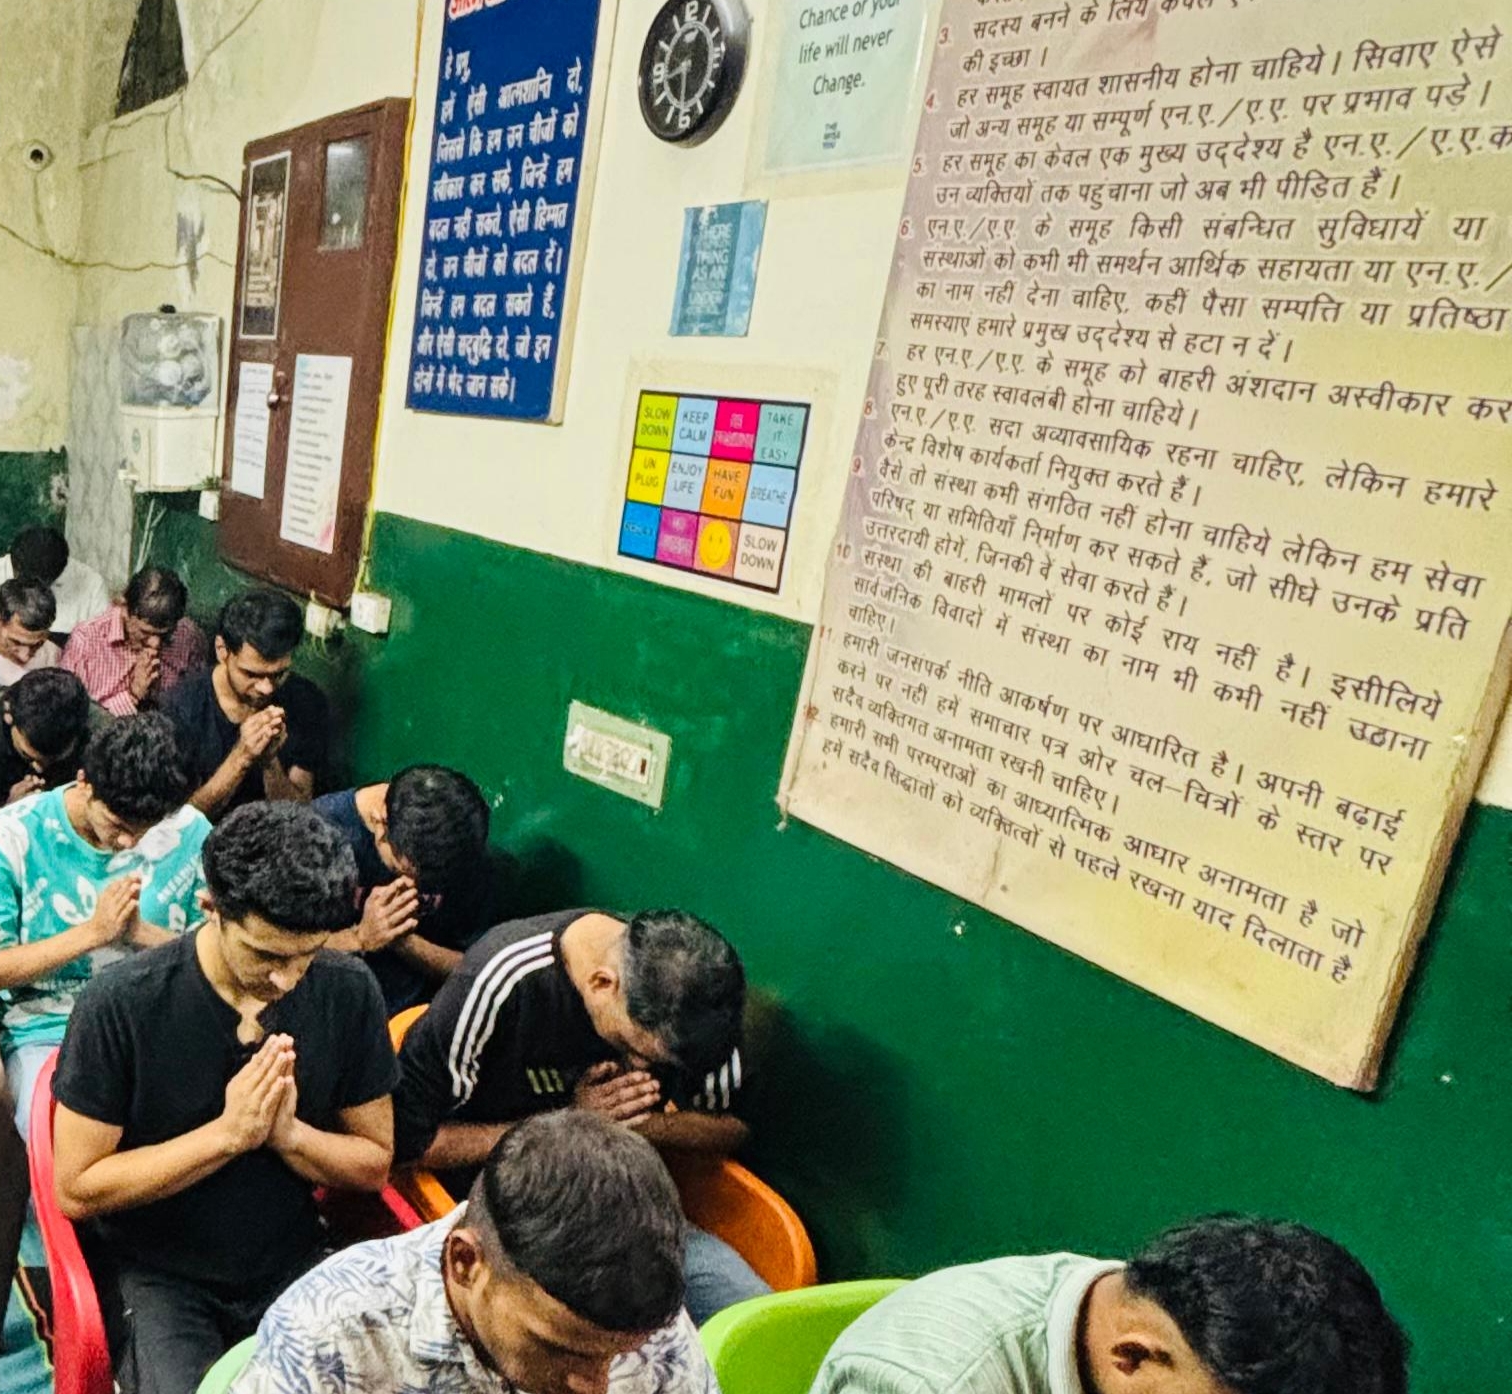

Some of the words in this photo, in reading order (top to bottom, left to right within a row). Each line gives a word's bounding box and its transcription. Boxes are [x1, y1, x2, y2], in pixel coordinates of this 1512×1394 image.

[799, 4, 849, 29] Chance
[799, 41, 821, 64] life
[825, 33, 849, 58] will
[852, 28, 893, 53] never
[957, 88, 979, 108] हर
[985, 83, 1026, 111] समूह
[1033, 77, 1090, 101] स्वायत
[1097, 62, 1181, 95] शासनीय
[1189, 55, 1242, 88] होना
[1252, 43, 1326, 80] चाहिये
[1352, 39, 1439, 72] सिवाए
[1451, 24, 1503, 66] ऐसे
[942, 154, 964, 173] हर
[969, 153, 1007, 177] समूह
[1014, 151, 1038, 170] का
[1044, 142, 1092, 169] केवल
[1099, 146, 1132, 170] एक
[1139, 142, 1188, 174] मुख्य
[1292, 127, 1313, 160] है
[916, 282, 937, 299] का
[945, 283, 975, 301] नाम
[1026, 280, 1061, 307] देना
[1202, 287, 1248, 318] पैसा
[1261, 291, 1345, 323] सम्पत्ति
[1360, 302, 1393, 326] या
[1407, 296, 1511, 332] प्रतिष्ठा
[976, 312, 1017, 338] हमारे
[1023, 321, 1071, 348] प्रमुख
[1158, 323, 1178, 351] से
[1183, 332, 1225, 356] हटा
[1232, 336, 1251, 357] न
[906, 343, 927, 361] हर
[1036, 350, 1054, 375] के
[1065, 360, 1108, 387] समूह
[1118, 358, 1148, 385] को
[1158, 364, 1217, 393] बाहरी
[1225, 369, 1318, 404] अंशदान
[1328, 380, 1453, 417] अस्वीकार
[643, 407, 670, 420] SLOW
[682, 411, 709, 424] KEEP
[768, 412, 794, 426] TAKE
[640, 424, 669, 438] DOWN
[679, 428, 707, 442] CALM
[761, 446, 788, 460] EASY
[671, 461, 703, 477] ENJOY
[989, 418, 1024, 439] सदा
[1166, 443, 1219, 470] रहना
[1325, 458, 1409, 498] लेकिन
[1423, 478, 1499, 512] हमारे
[713, 469, 741, 483] HAVE
[673, 481, 695, 494] LIFE
[713, 486, 736, 501] FUN
[750, 487, 787, 504] BREATHE
[909, 463, 927, 485] तो
[1100, 502, 1137, 529] नहीं
[1144, 508, 1194, 541] होना
[1204, 523, 1272, 557] चाहिये
[1282, 533, 1362, 575] लेकिन
[1370, 557, 1413, 585] हम
[1425, 560, 1487, 599] सेवा
[744, 534, 778, 552] SLOW
[741, 552, 775, 571] DOWN
[913, 559, 933, 582] की
[943, 572, 987, 596] बाहरी
[1067, 603, 1092, 626] पर
[1104, 610, 1149, 645] कोई
[1163, 628, 1200, 656] राय
[1215, 642, 1258, 672] नहीं
[1330, 673, 1443, 721] इसीलिये
[942, 790, 964, 813] को
[1049, 834, 1067, 860] से
[1074, 848, 1121, 881] पहले
[1129, 871, 1186, 910] रखना
[1192, 898, 1236, 932] याद
[1242, 913, 1325, 972] दिलाता
